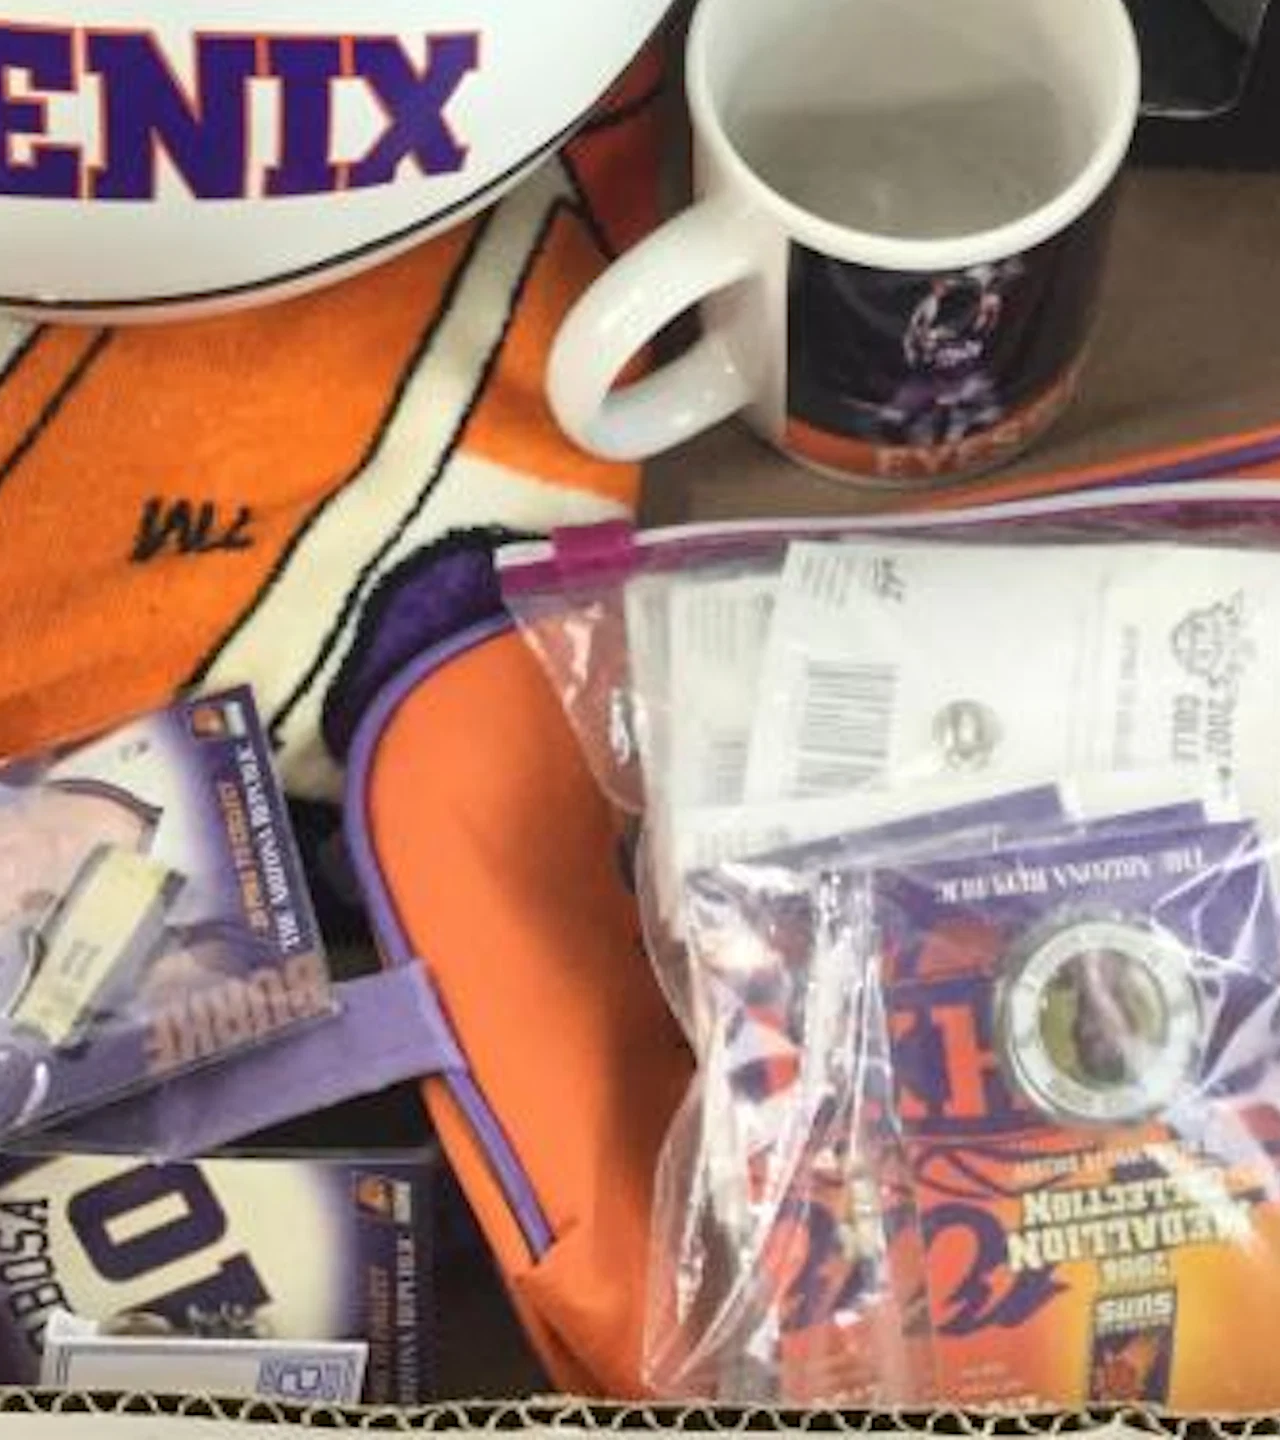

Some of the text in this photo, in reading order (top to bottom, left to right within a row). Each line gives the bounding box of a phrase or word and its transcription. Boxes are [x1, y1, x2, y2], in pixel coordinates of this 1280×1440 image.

[234, 741, 270, 828] REPUBLIC
[256, 829, 290, 906] ARIZONA
[1007, 1200, 1252, 1273] MEDALLION
